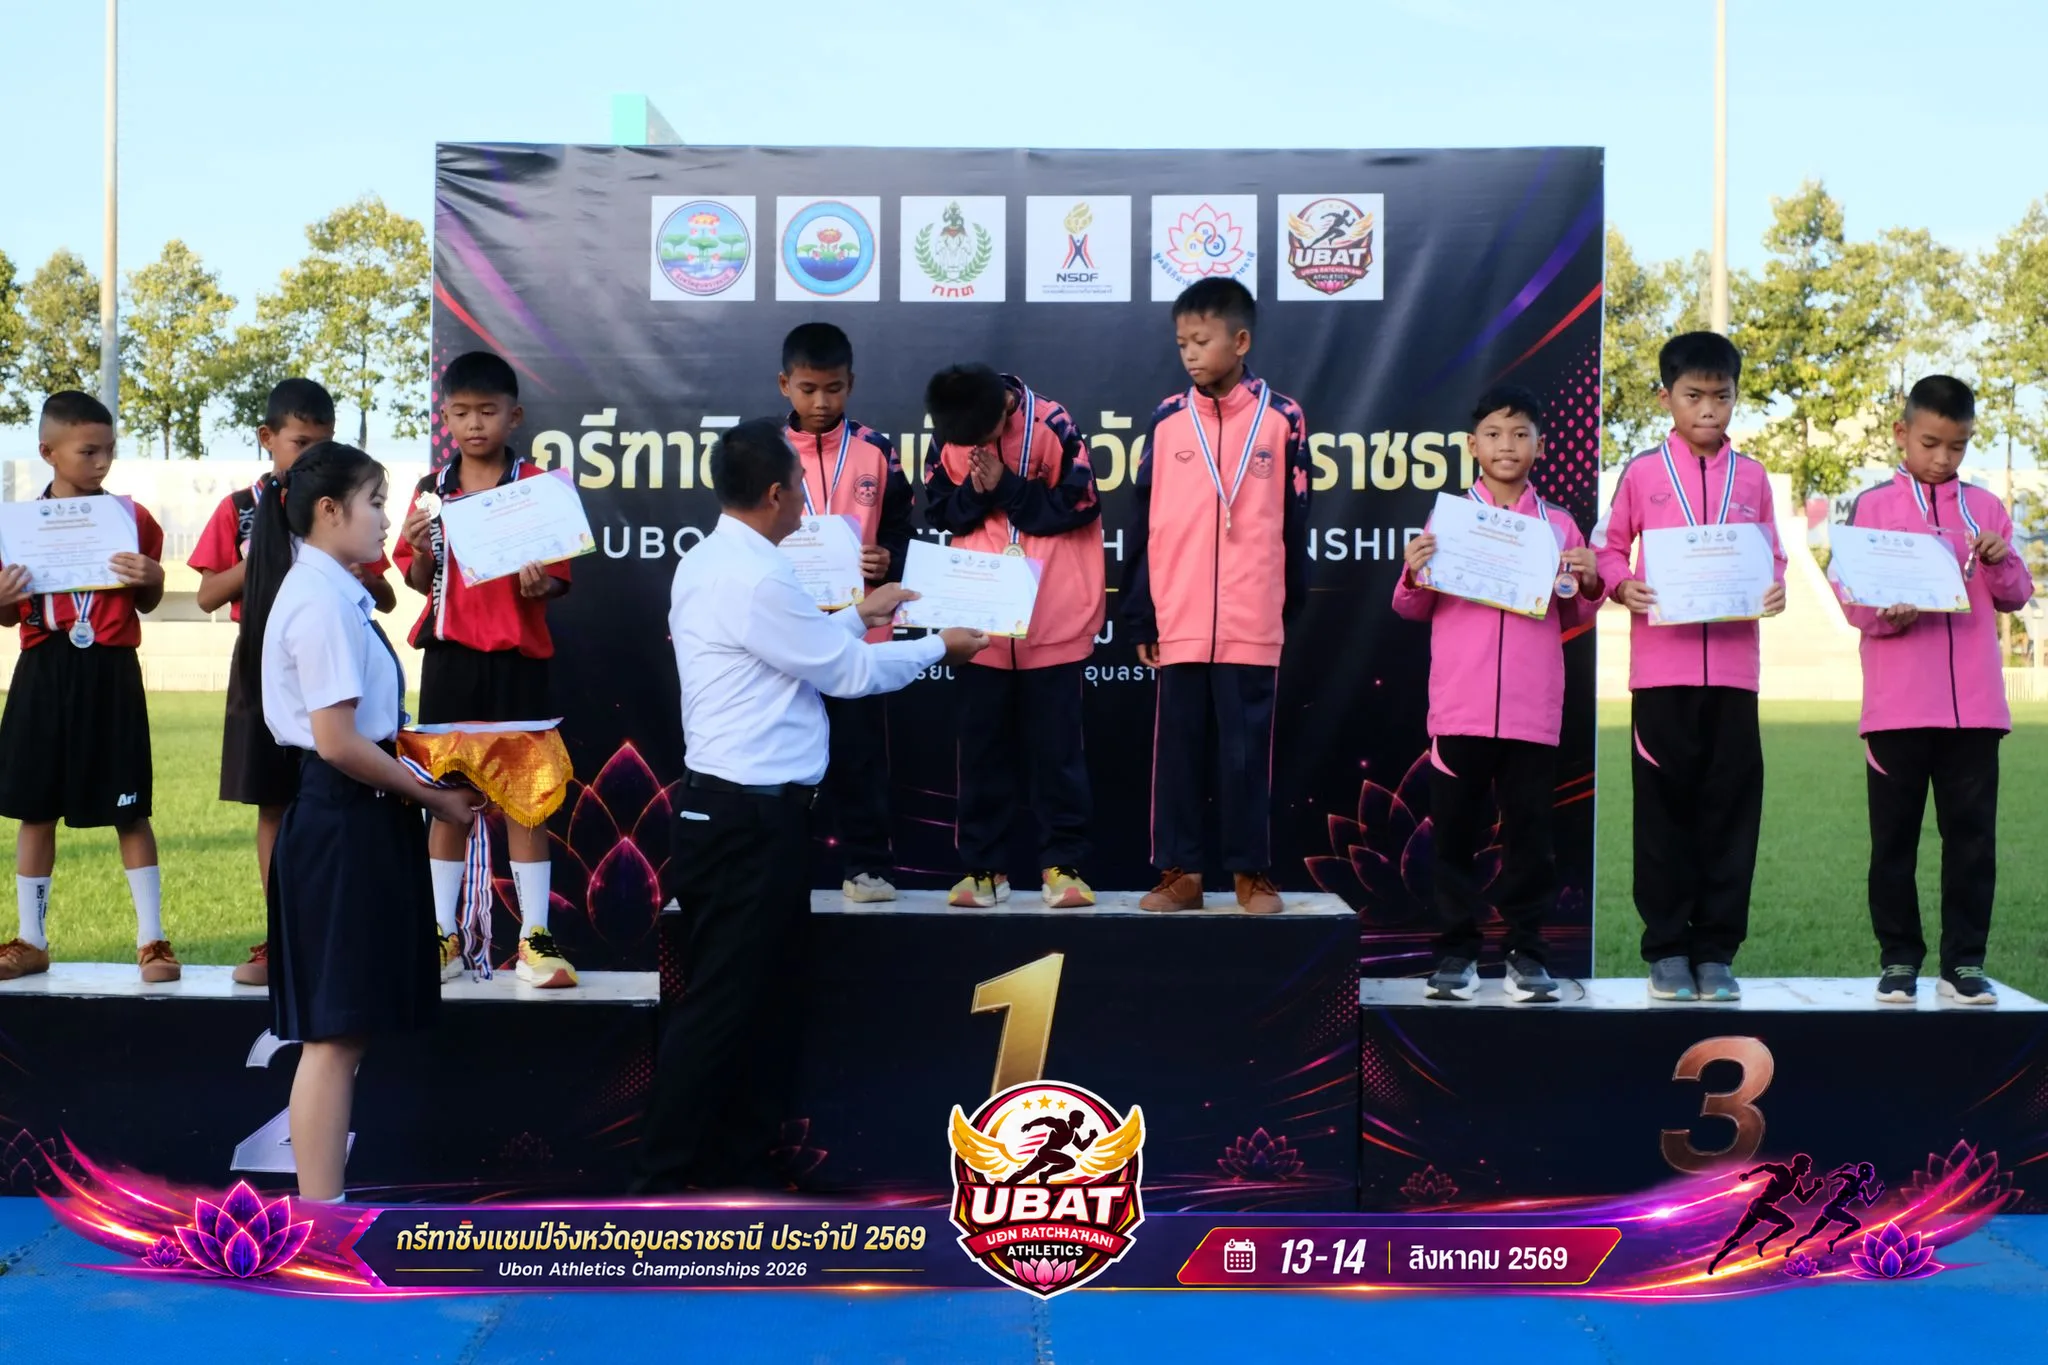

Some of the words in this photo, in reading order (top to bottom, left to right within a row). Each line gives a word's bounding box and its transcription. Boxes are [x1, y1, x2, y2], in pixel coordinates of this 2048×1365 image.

[1294, 248, 1368, 268] UBAT
[1056, 272, 1099, 282] NSDF
[603, 526, 706, 560] UBO
[117, 792, 137, 807] Ari
[972, 953, 1064, 1096] 1
[1660, 1036, 1775, 1175] 3
